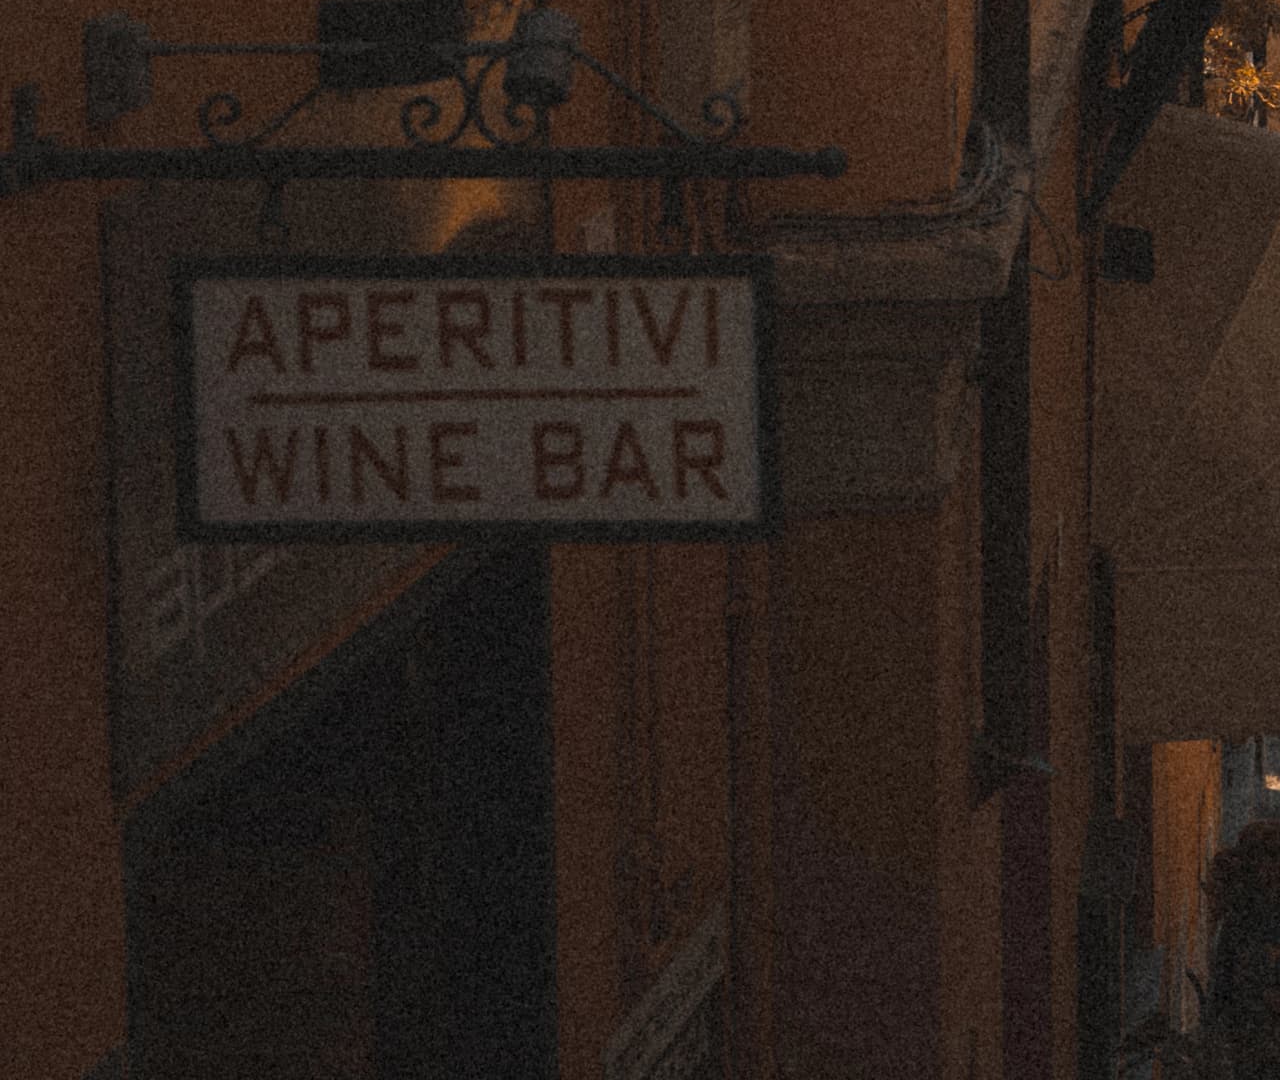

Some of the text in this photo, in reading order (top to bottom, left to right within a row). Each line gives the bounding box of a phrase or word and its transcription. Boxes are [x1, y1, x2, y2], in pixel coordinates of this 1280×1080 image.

[226, 286, 720, 374] APERITIVI
[225, 417, 732, 506] WINE BAR
